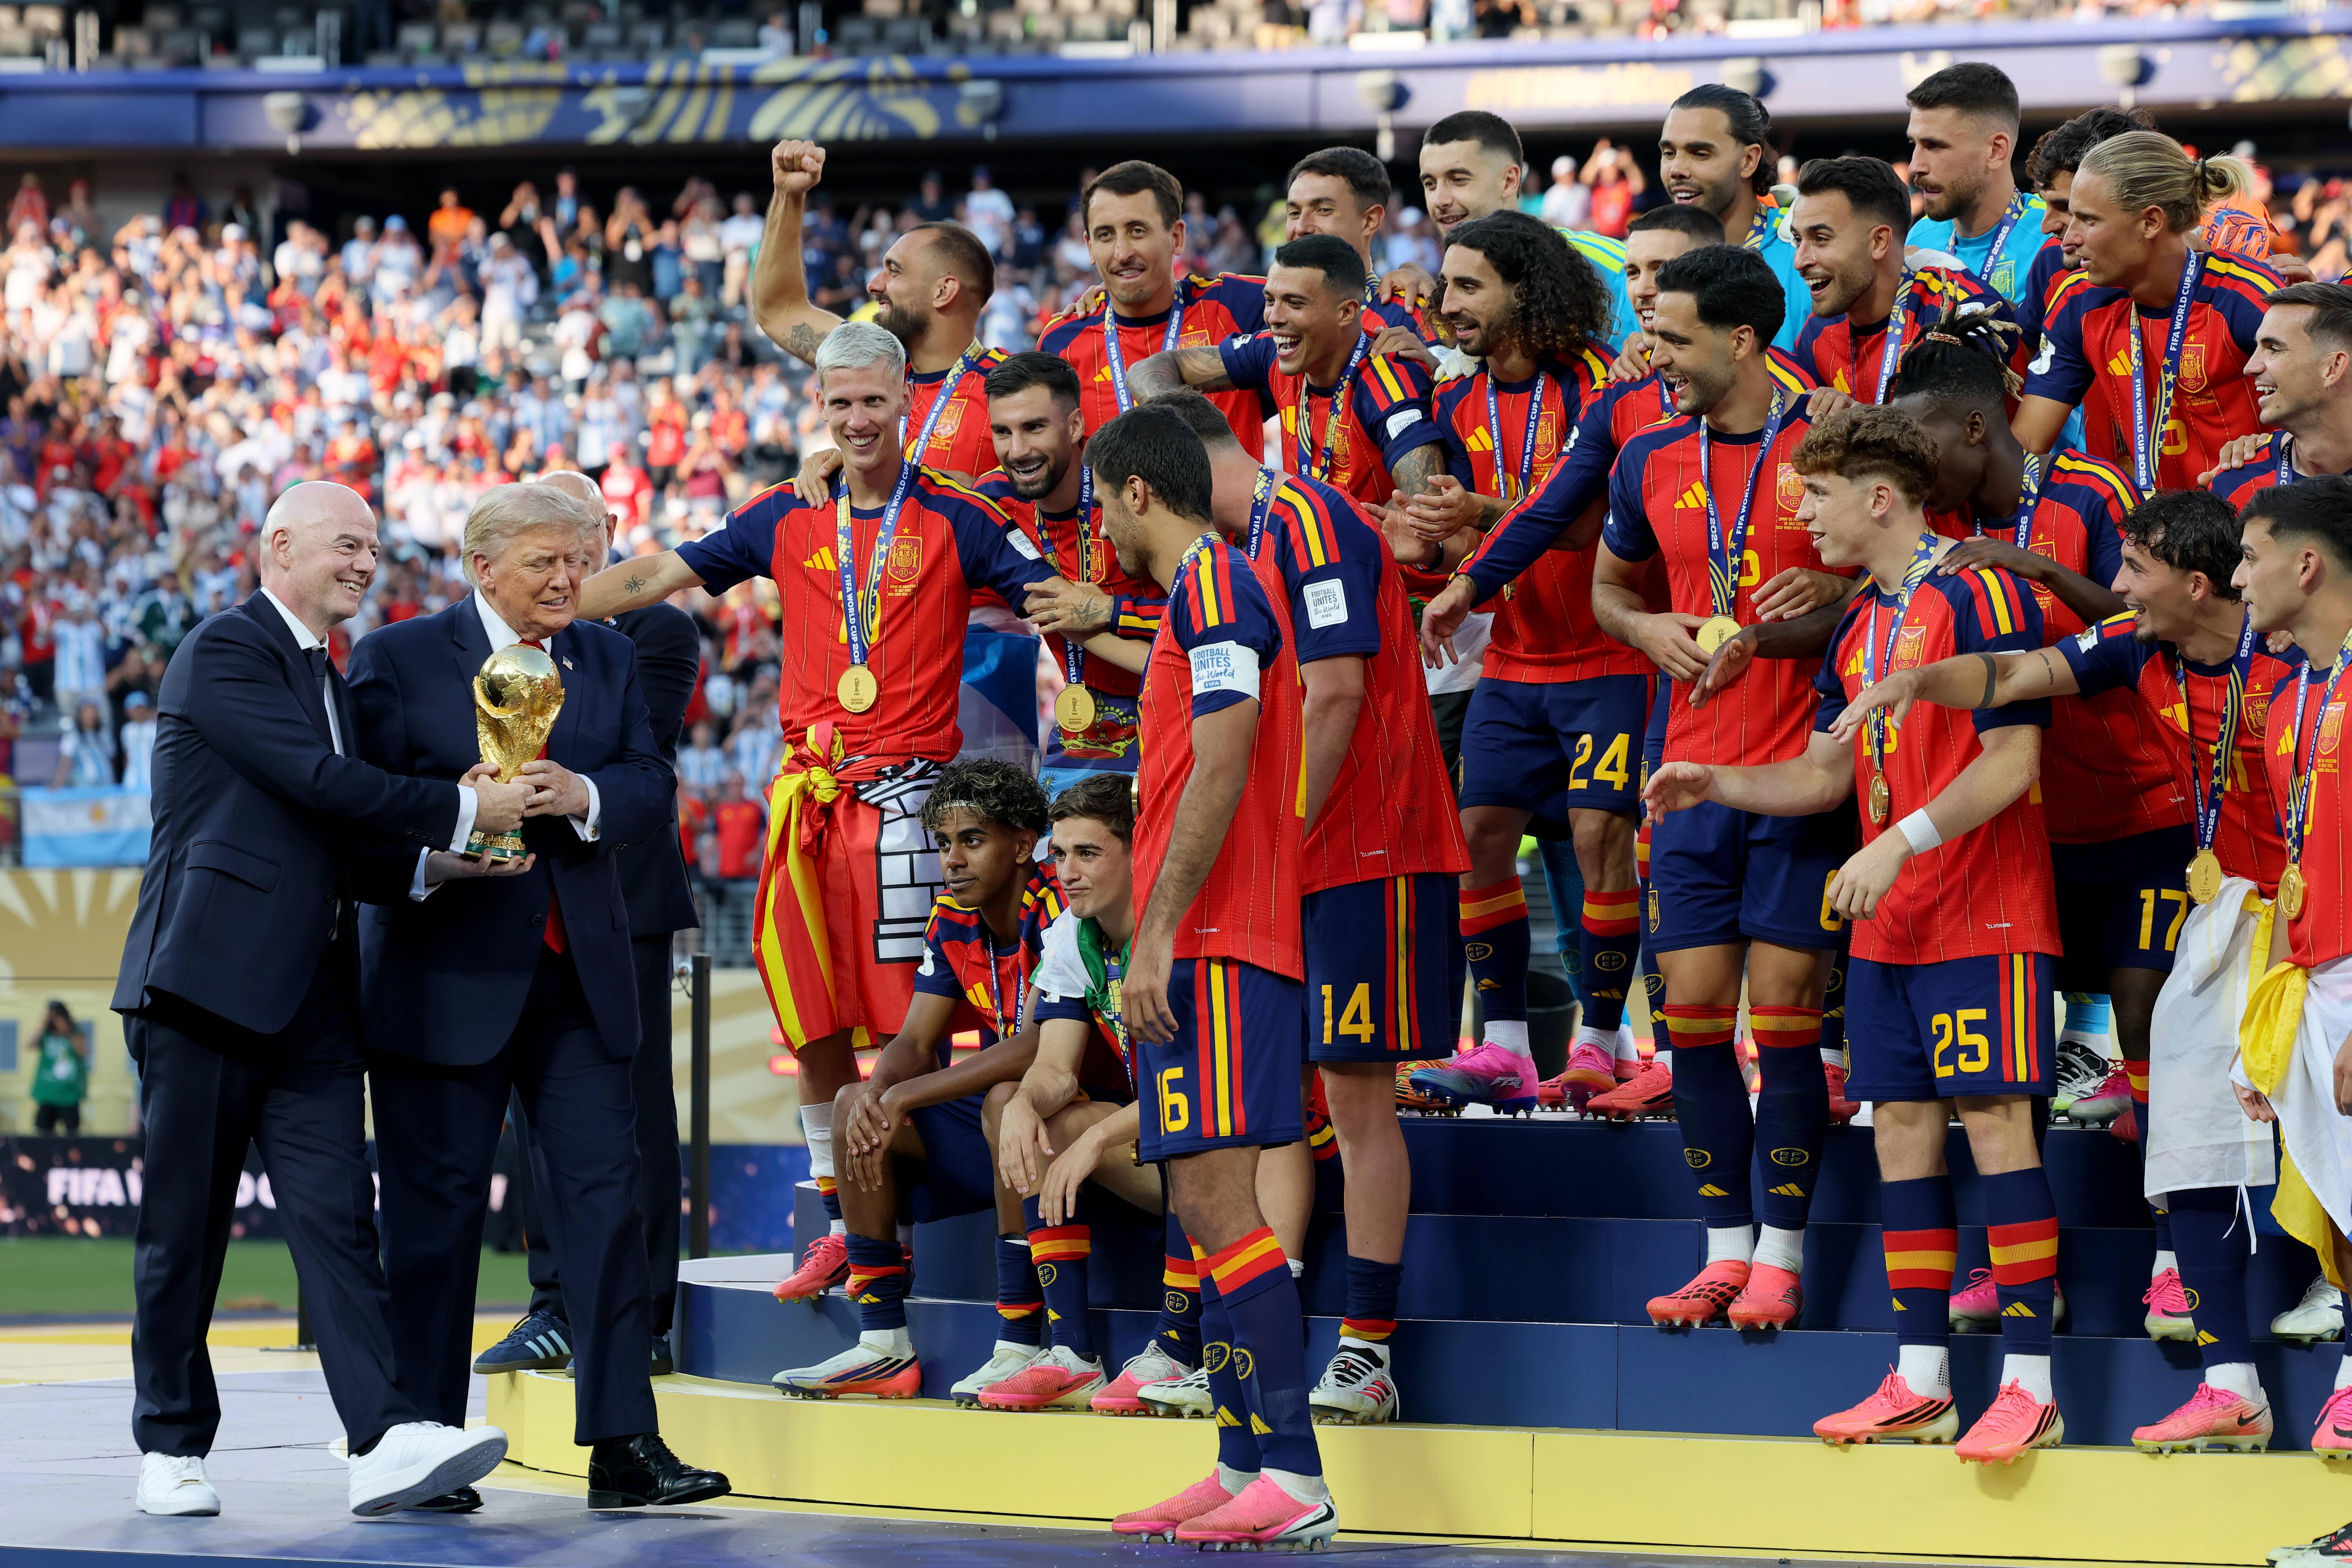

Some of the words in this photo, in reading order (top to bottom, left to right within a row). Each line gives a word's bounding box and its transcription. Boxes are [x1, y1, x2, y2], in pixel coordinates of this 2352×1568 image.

[1986, 256, 1995, 272] CUP
[1993, 225, 2009, 255] 2026
[2180, 275, 2191, 296] CUP
[1169, 310, 1180, 338] 2026
[2174, 296, 2187, 331] WORLD
[2170, 329, 2180, 351] FIFA
[1349, 348, 1363, 367] FIFA
[1884, 343, 1896, 374] 2026
[1113, 359, 1124, 388] WORLD
[1119, 388, 1128, 406] CUP
[1534, 371, 1546, 401] 2026
[1880, 375, 1889, 394] CUP
[933, 395, 946, 414] FIFA
[1530, 402, 1538, 420] CUP
[921, 412, 937, 440] WORLD
[1526, 421, 1535, 453] WORLD
[1761, 428, 1773, 450] FIFA
[915, 441, 924, 457] CUP
[2281, 446, 2289, 478] WORLD
[2138, 453, 2147, 486] 2026
[885, 506, 896, 526] FIFA
[891, 480, 905, 506] WORLD
[1736, 515, 1745, 535] FIFA
[1741, 480, 1752, 513] WORLD
[1252, 515, 1261, 535] FIFA
[1710, 517, 1719, 550] 2026
[2017, 515, 2028, 549] 2026
[844, 574, 852, 594] FIFA
[1311, 588, 1336, 598] FOOTBALL
[847, 594, 856, 624] WORLD
[1313, 594, 1338, 607] UNITES
[1313, 605, 1323, 614] the
[1323, 602, 1340, 613] World
[852, 643, 860, 664] 202
[1194, 648, 1231, 662] FOOTBALL
[1886, 628, 1896, 660] 2026
[1068, 652, 1077, 683] WORLD
[1194, 657, 1231, 673] UNITES
[1194, 672, 1206, 683] the
[1207, 669, 1235, 680] World
[2299, 660, 2310, 695] WORLD
[2316, 705, 2325, 726] FIFA
[2307, 726, 2319, 765] WORLD
[1569, 733, 1630, 791] 24
[2206, 808, 2216, 842] 2026
[2139, 889, 2188, 951] 17
[1321, 983, 1375, 1044] 14
[1932, 1009, 1989, 1078] 25
[1157, 1067, 1189, 1136] 16
[48, 1168, 126, 1206] FIFA
